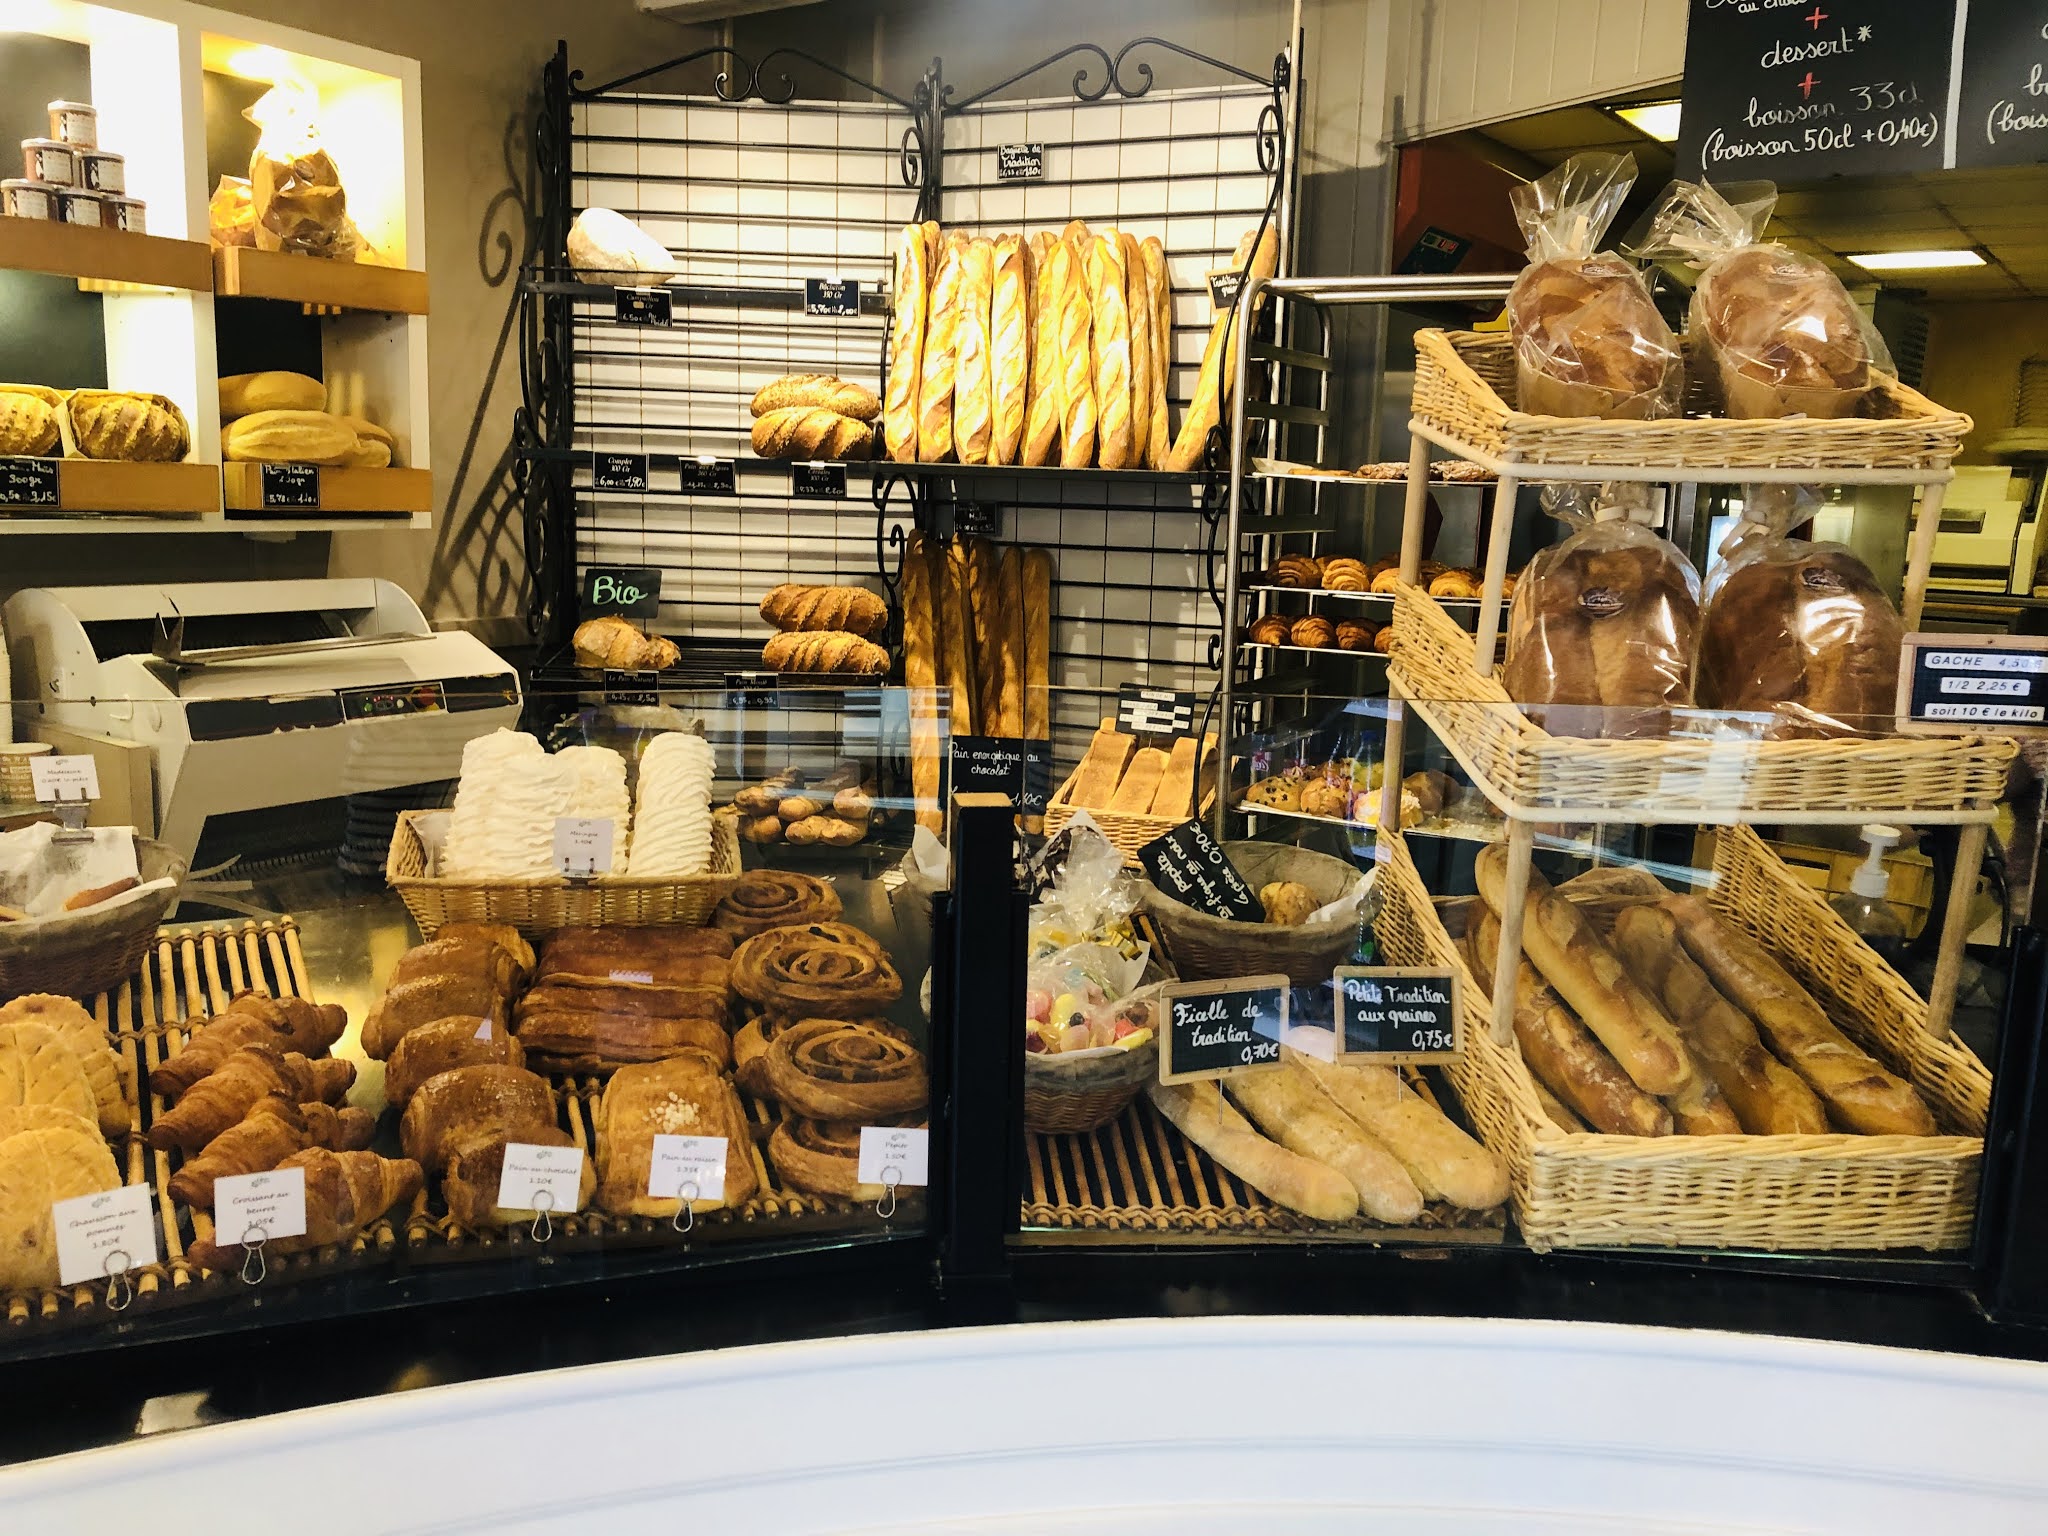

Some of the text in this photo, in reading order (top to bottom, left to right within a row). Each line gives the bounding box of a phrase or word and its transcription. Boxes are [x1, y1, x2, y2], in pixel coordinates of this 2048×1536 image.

[1701, 127, 1801, 170] (boisson
[1804, 125, 1855, 152] 50cl
[593, 575, 648, 605] Bio
[1931, 655, 1984, 667] GACHE
[1948, 680, 2021, 692] 1/2 2,25 €
[1931, 706, 2038, 718] soit 10 € le kilo
[1027, 753, 1041, 763] au
[971, 764, 1011, 776] chocolat
[1384, 984, 1450, 1004] Tradition
[1242, 997, 1264, 1018] de
[1358, 1009, 1437, 1029] aux graines
[1191, 1023, 1252, 1048] tradition
[1412, 1029, 1454, 1051] 0,75€
[1241, 1042, 1279, 1065] 0,70€
